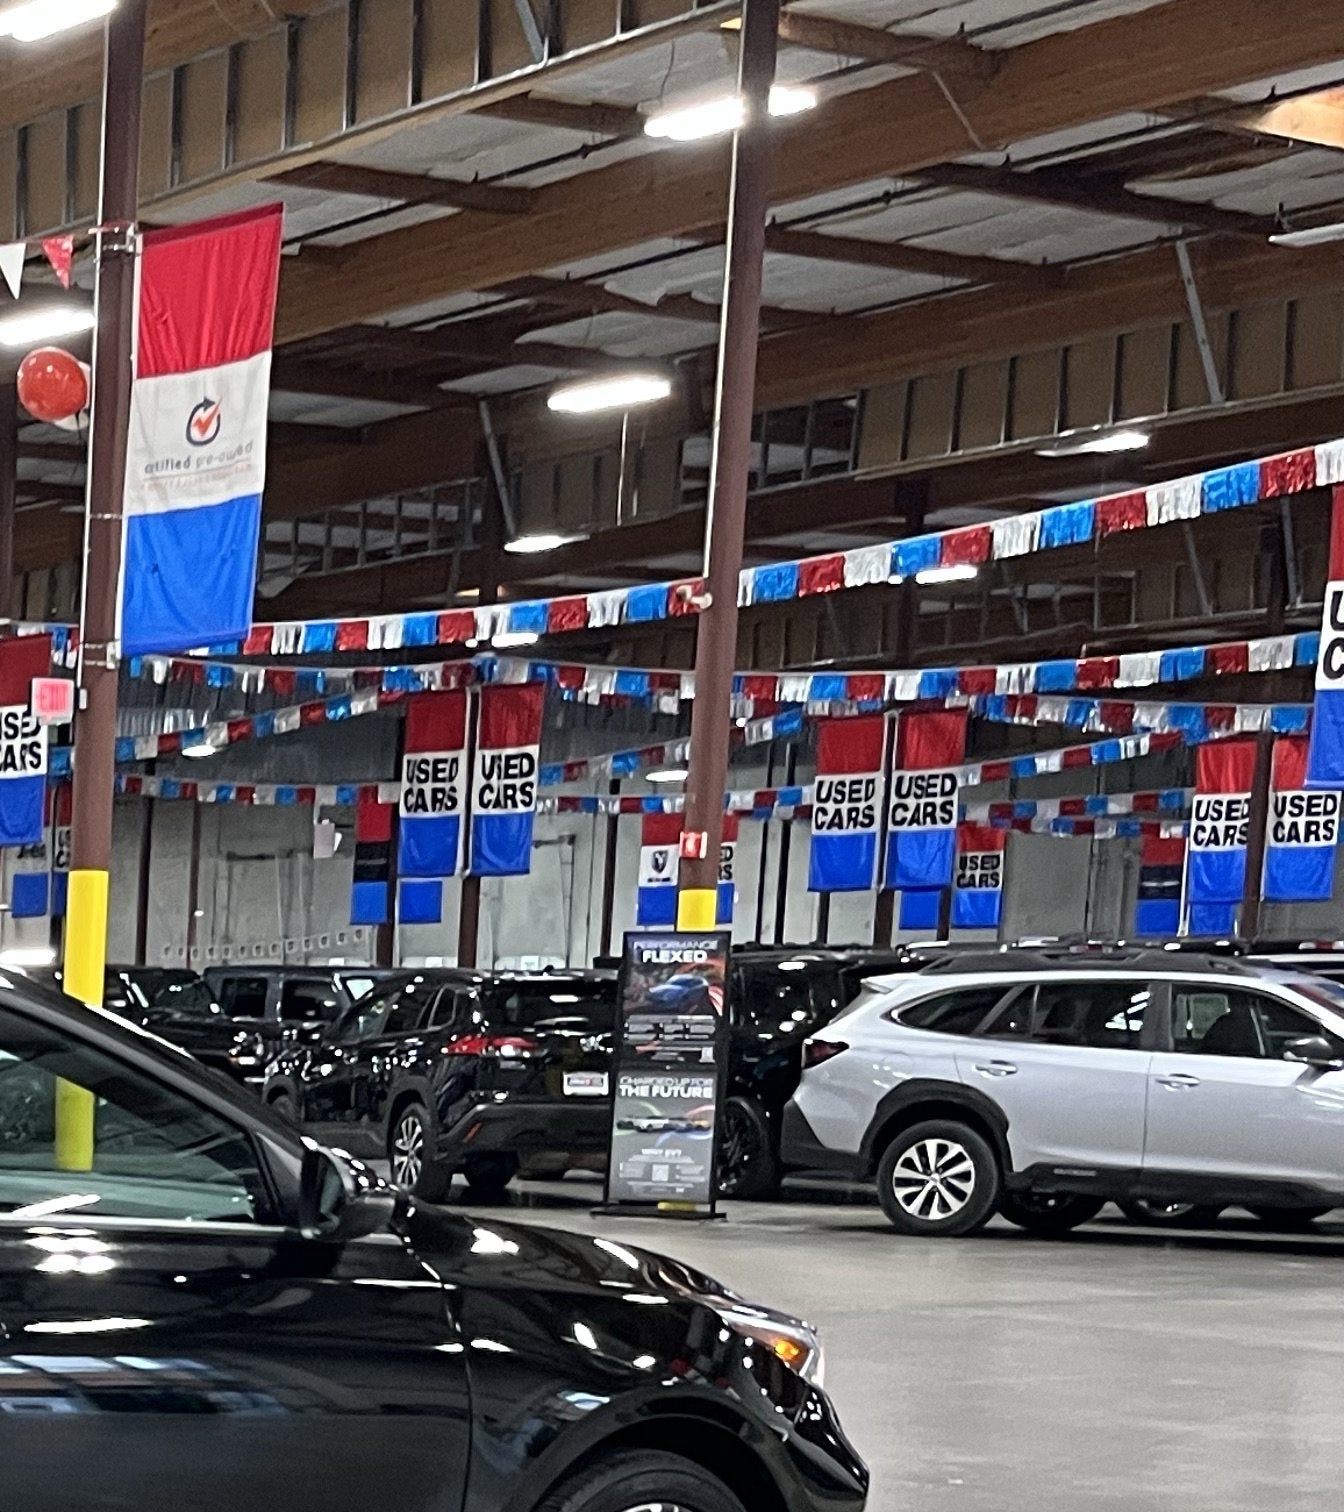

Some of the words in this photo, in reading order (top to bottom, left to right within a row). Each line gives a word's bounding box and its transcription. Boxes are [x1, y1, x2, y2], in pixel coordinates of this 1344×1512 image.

[406, 757, 459, 785] USED
[482, 752, 535, 781] USED
[478, 781, 535, 810] CARS
[816, 778, 875, 804] USED
[895, 773, 957, 800] USED
[404, 786, 459, 813] CARS
[1194, 798, 1250, 822] USED
[1274, 794, 1338, 818] USED
[814, 804, 875, 830] CARS
[891, 799, 954, 827] CARS
[1192, 823, 1249, 847] CARS
[1273, 819, 1335, 844] CARS
[959, 854, 1001, 871] USED
[956, 871, 1000, 889] CARS
[642, 949, 708, 963] FLEXED
[619, 1084, 650, 1097] THE
[652, 1084, 713, 1099] FUTURE
